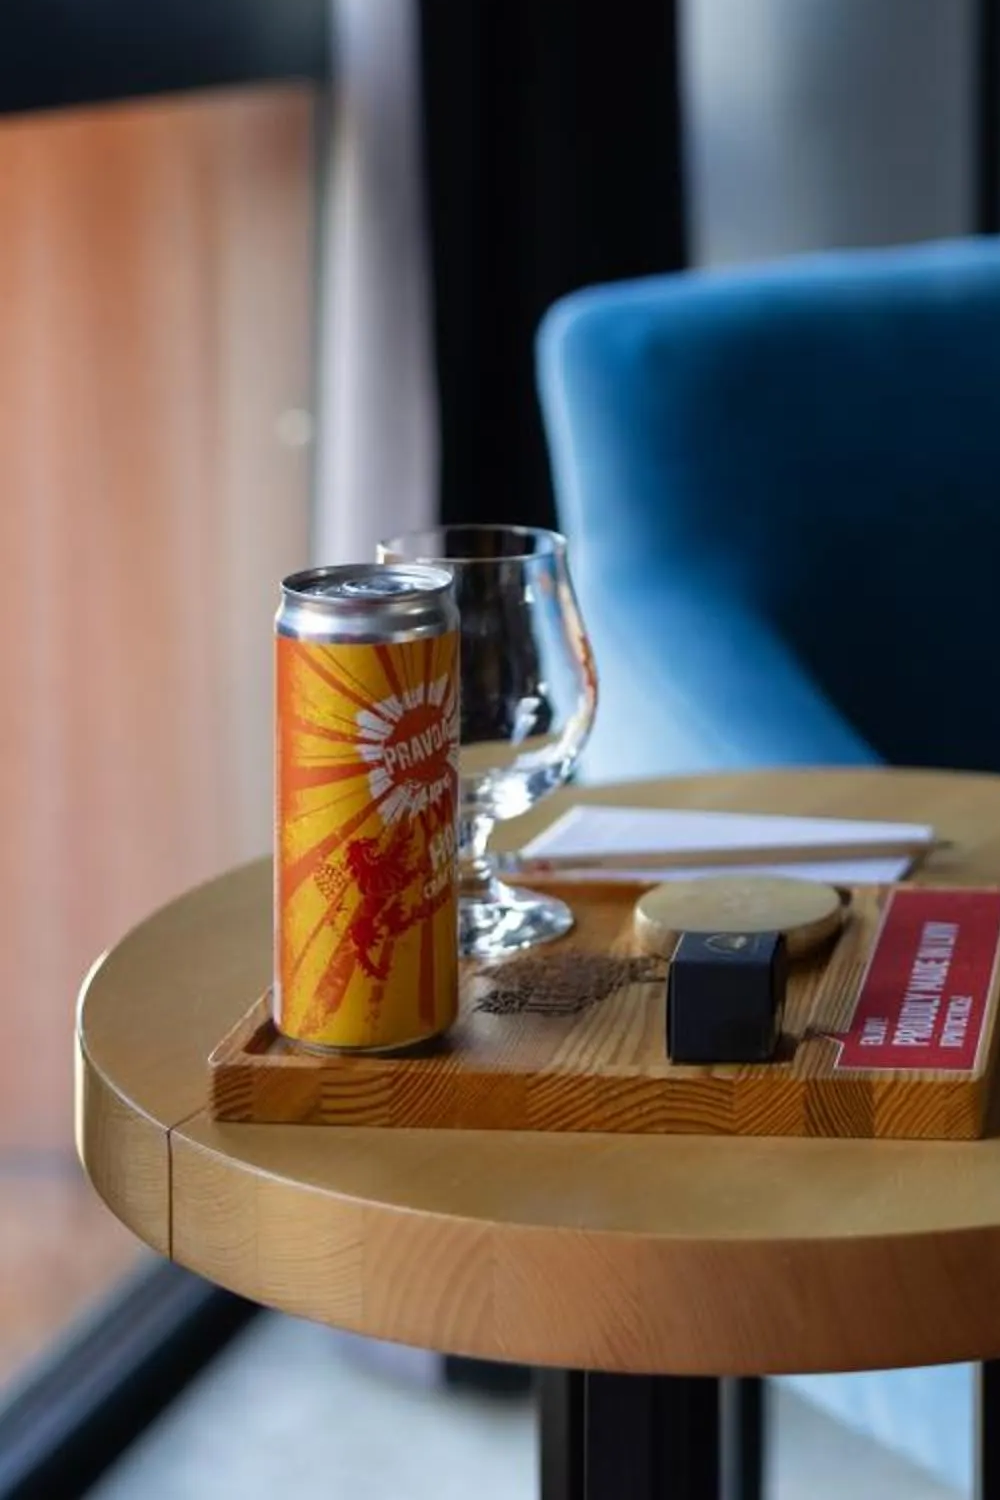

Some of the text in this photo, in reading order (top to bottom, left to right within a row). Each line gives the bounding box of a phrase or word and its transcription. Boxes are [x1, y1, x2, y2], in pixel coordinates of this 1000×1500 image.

[918, 945, 953, 958] IN
[905, 959, 950, 991] MADE
[892, 994, 940, 1046] PROUDLY
